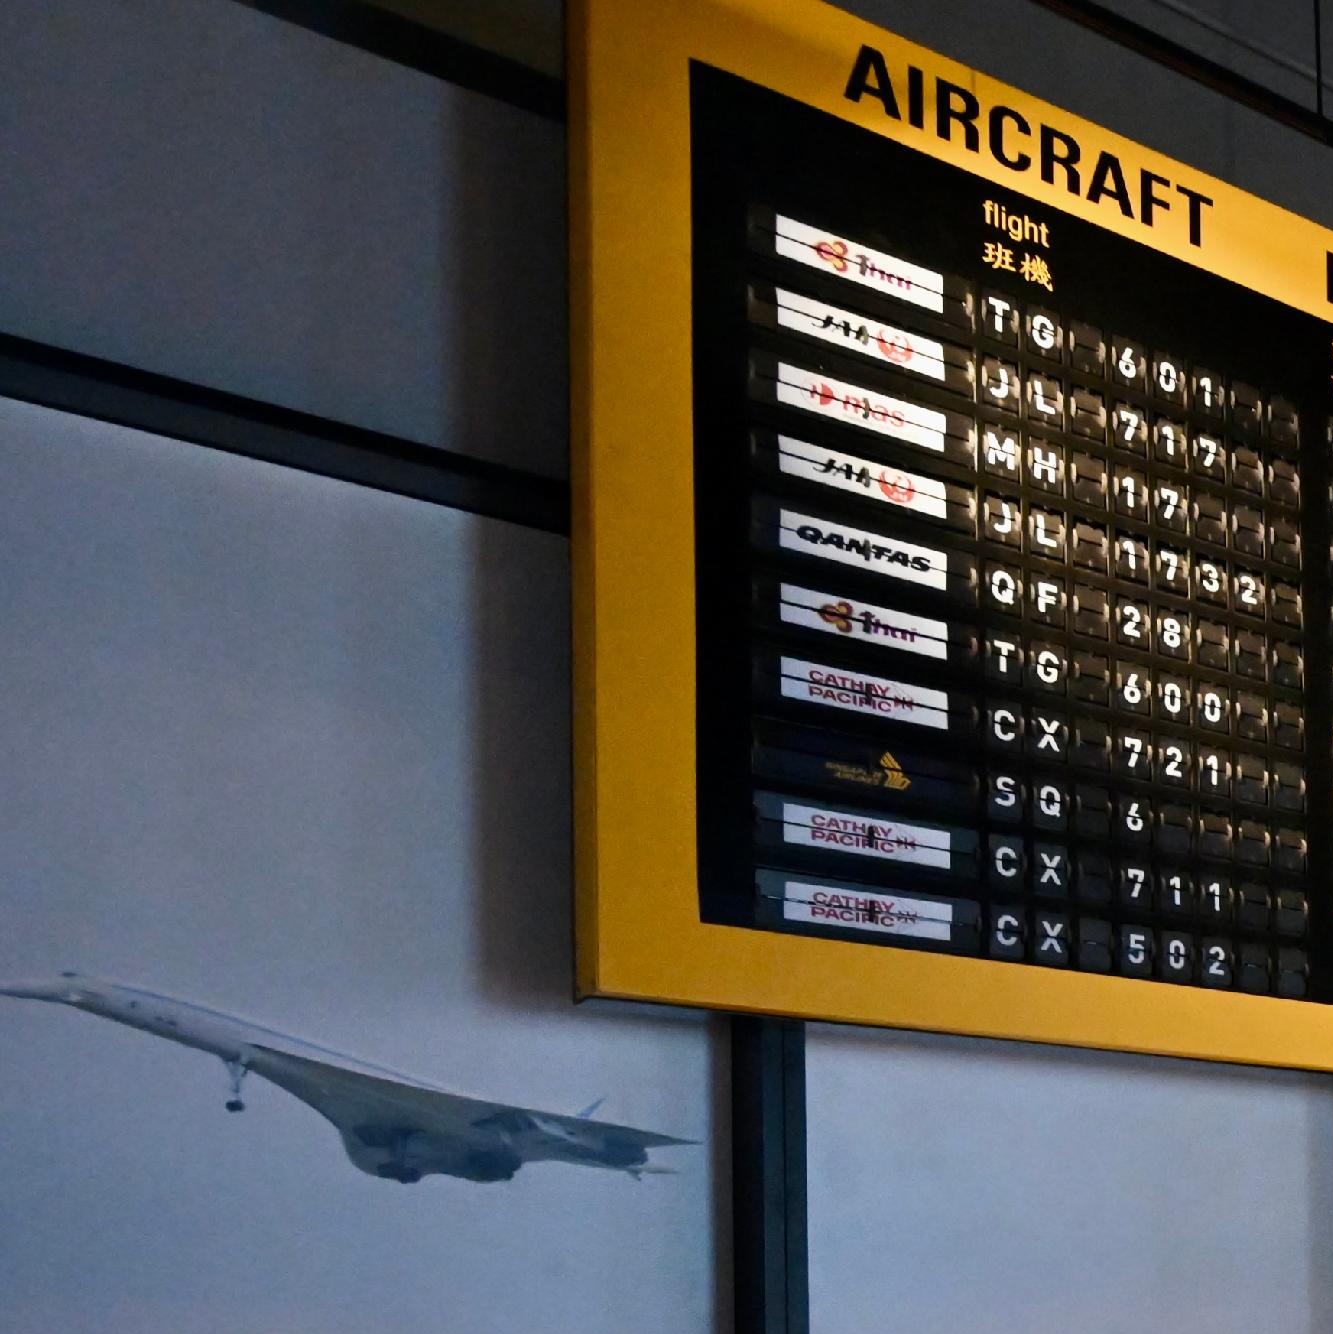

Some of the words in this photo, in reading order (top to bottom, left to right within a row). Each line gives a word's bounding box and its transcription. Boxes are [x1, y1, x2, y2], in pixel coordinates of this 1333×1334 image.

[844, 44, 1213, 248] AIRCRAFT
[983, 200, 1050, 248] flight
[982, 243, 1054, 292] 班機
[987, 295, 1055, 350] TG
[1119, 347, 1212, 407] 601
[989, 369, 1056, 416] JL
[1121, 411, 1217, 468] 717
[987, 431, 1057, 484] MH
[1122, 475, 1178, 520] 17
[797, 522, 931, 573] QANTAS
[995, 503, 1059, 548] JL
[1123, 539, 1259, 605] 1732
[992, 573, 1058, 612] QF
[1123, 606, 1182, 649] 28
[809, 669, 890, 697] CATHAY
[994, 640, 1060, 683] TG
[1123, 672, 1221, 723] 600
[994, 709, 1061, 753] CX
[1125, 736, 1219, 786] 721
[811, 815, 892, 837] CATHAY
[995, 776, 1061, 817] SQ
[1127, 803, 1143, 832] 6
[813, 892, 895, 911] CATHAY
[996, 846, 1061, 887] CX
[1127, 868, 1223, 912] 711
[998, 913, 1062, 953] CX
[1129, 935, 1225, 976] 502
